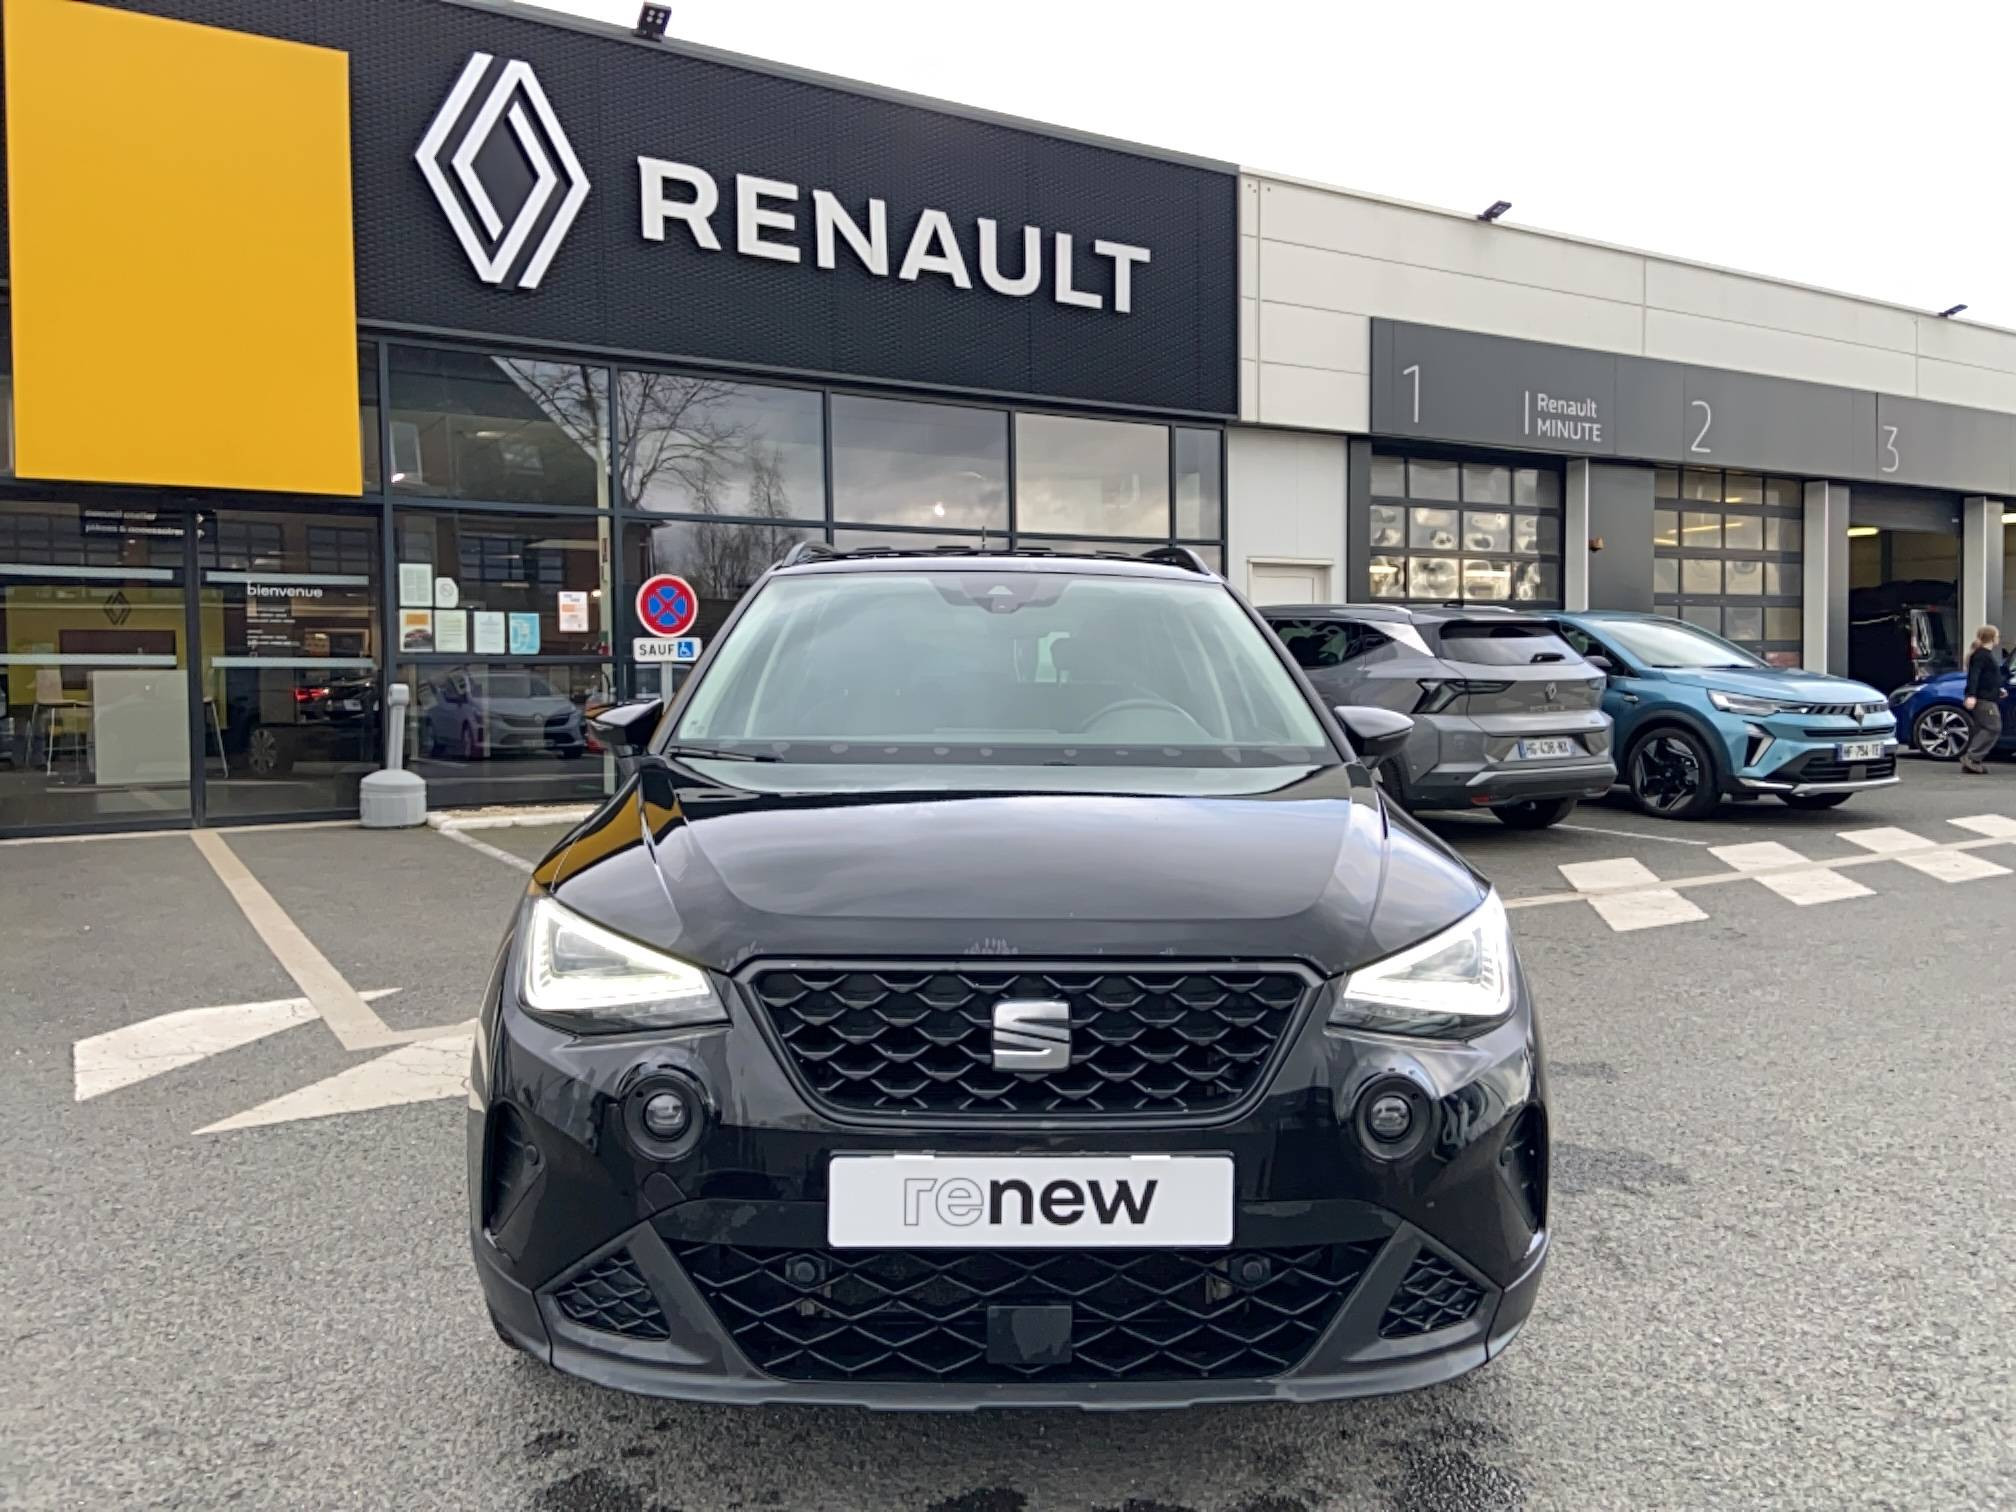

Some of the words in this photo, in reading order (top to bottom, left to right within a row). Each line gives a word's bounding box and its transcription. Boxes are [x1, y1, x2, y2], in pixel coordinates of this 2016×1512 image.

[637, 156, 1151, 313] RENAULT
[1403, 365, 1420, 423] 1
[1537, 392, 1597, 418] Renault
[1537, 418, 1602, 442] MINUTE
[1691, 401, 1712, 453] 2
[1880, 425, 1899, 472] 3
[246, 580, 323, 598] bienvenue
[639, 643, 676, 656] SAUF
[903, 1177, 1159, 1227] renew
